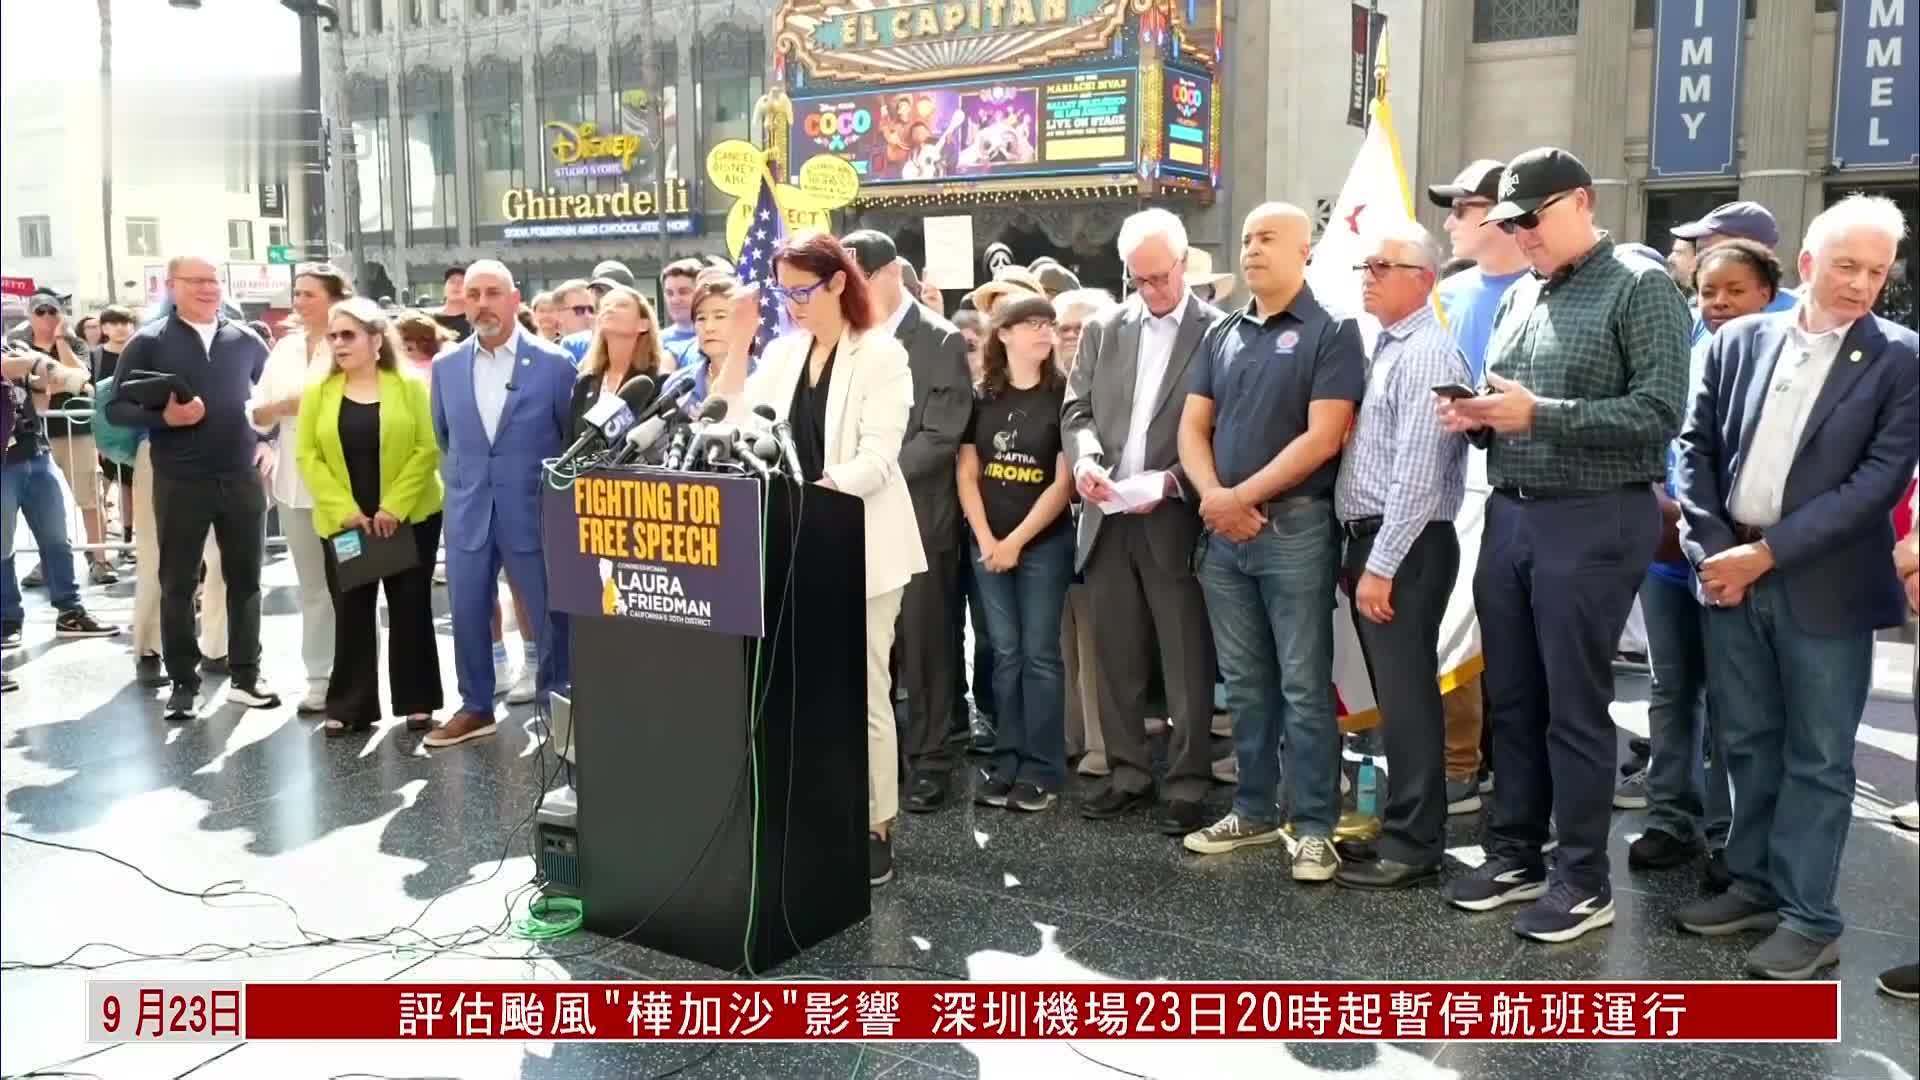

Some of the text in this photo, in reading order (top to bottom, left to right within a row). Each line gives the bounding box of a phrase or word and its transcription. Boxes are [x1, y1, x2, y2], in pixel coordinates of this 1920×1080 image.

[842, 0, 1067, 44] EL CAPITAN
[1172, 83, 1202, 107] COCO
[804, 109, 872, 137] COCO
[1046, 114, 1126, 130] LIVE ON STAGE
[502, 178, 689, 221] Ghirardelli
[578, 223, 598, 235] AND
[574, 477, 721, 525] FIGHTING FOR
[579, 517, 718, 567] FREE SPEECH
[618, 571, 684, 597] LAURA
[628, 592, 711, 618] FRIEDMAN
